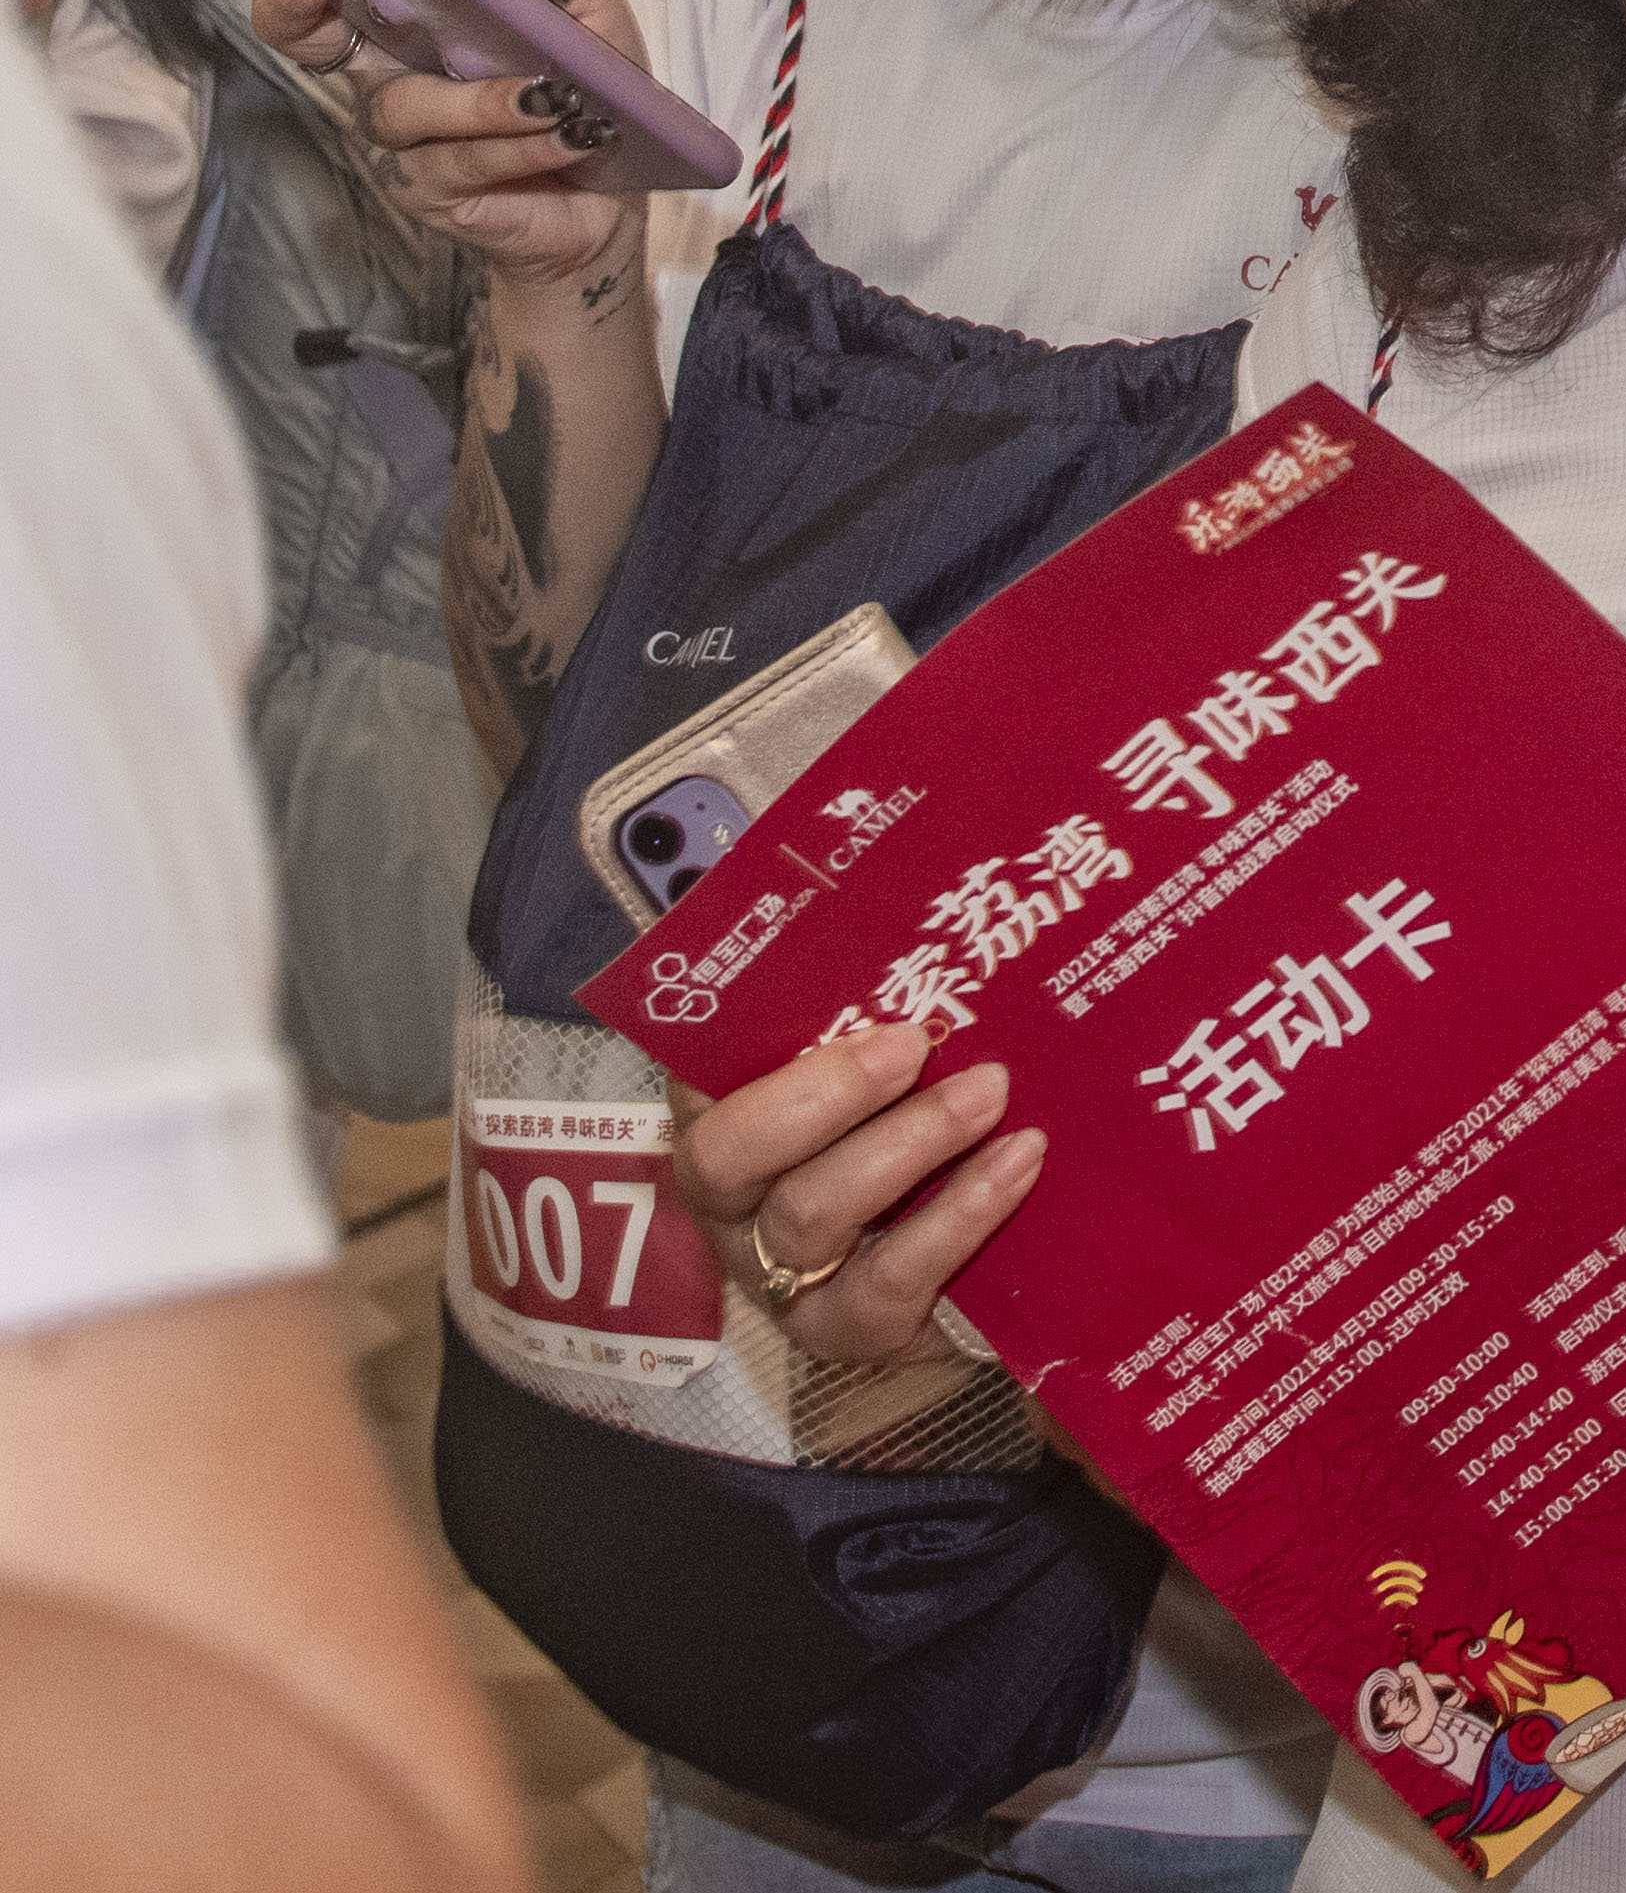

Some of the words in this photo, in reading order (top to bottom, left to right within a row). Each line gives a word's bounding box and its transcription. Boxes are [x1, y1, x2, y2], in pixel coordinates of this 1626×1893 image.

[647, 626, 737, 668] CAMEL
[797, 814, 1133, 1058] 索荔湾
[1099, 551, 1447, 818] 寻味西关
[828, 786, 928, 870] CAMEL
[689, 892, 787, 985] 恒宝广场
[713, 954, 753, 990] HENG
[1138, 877, 1452, 1151] 活动卡
[478, 1168, 656, 1307] 007
[1400, 1331, 1511, 1428] 09:30-10:00
[1430, 1361, 1540, 1457] 10:00-10:40
[1457, 1386, 1576, 1488] 10:40-14:40
[1485, 1417, 1603, 1519] 14:40-15:00
